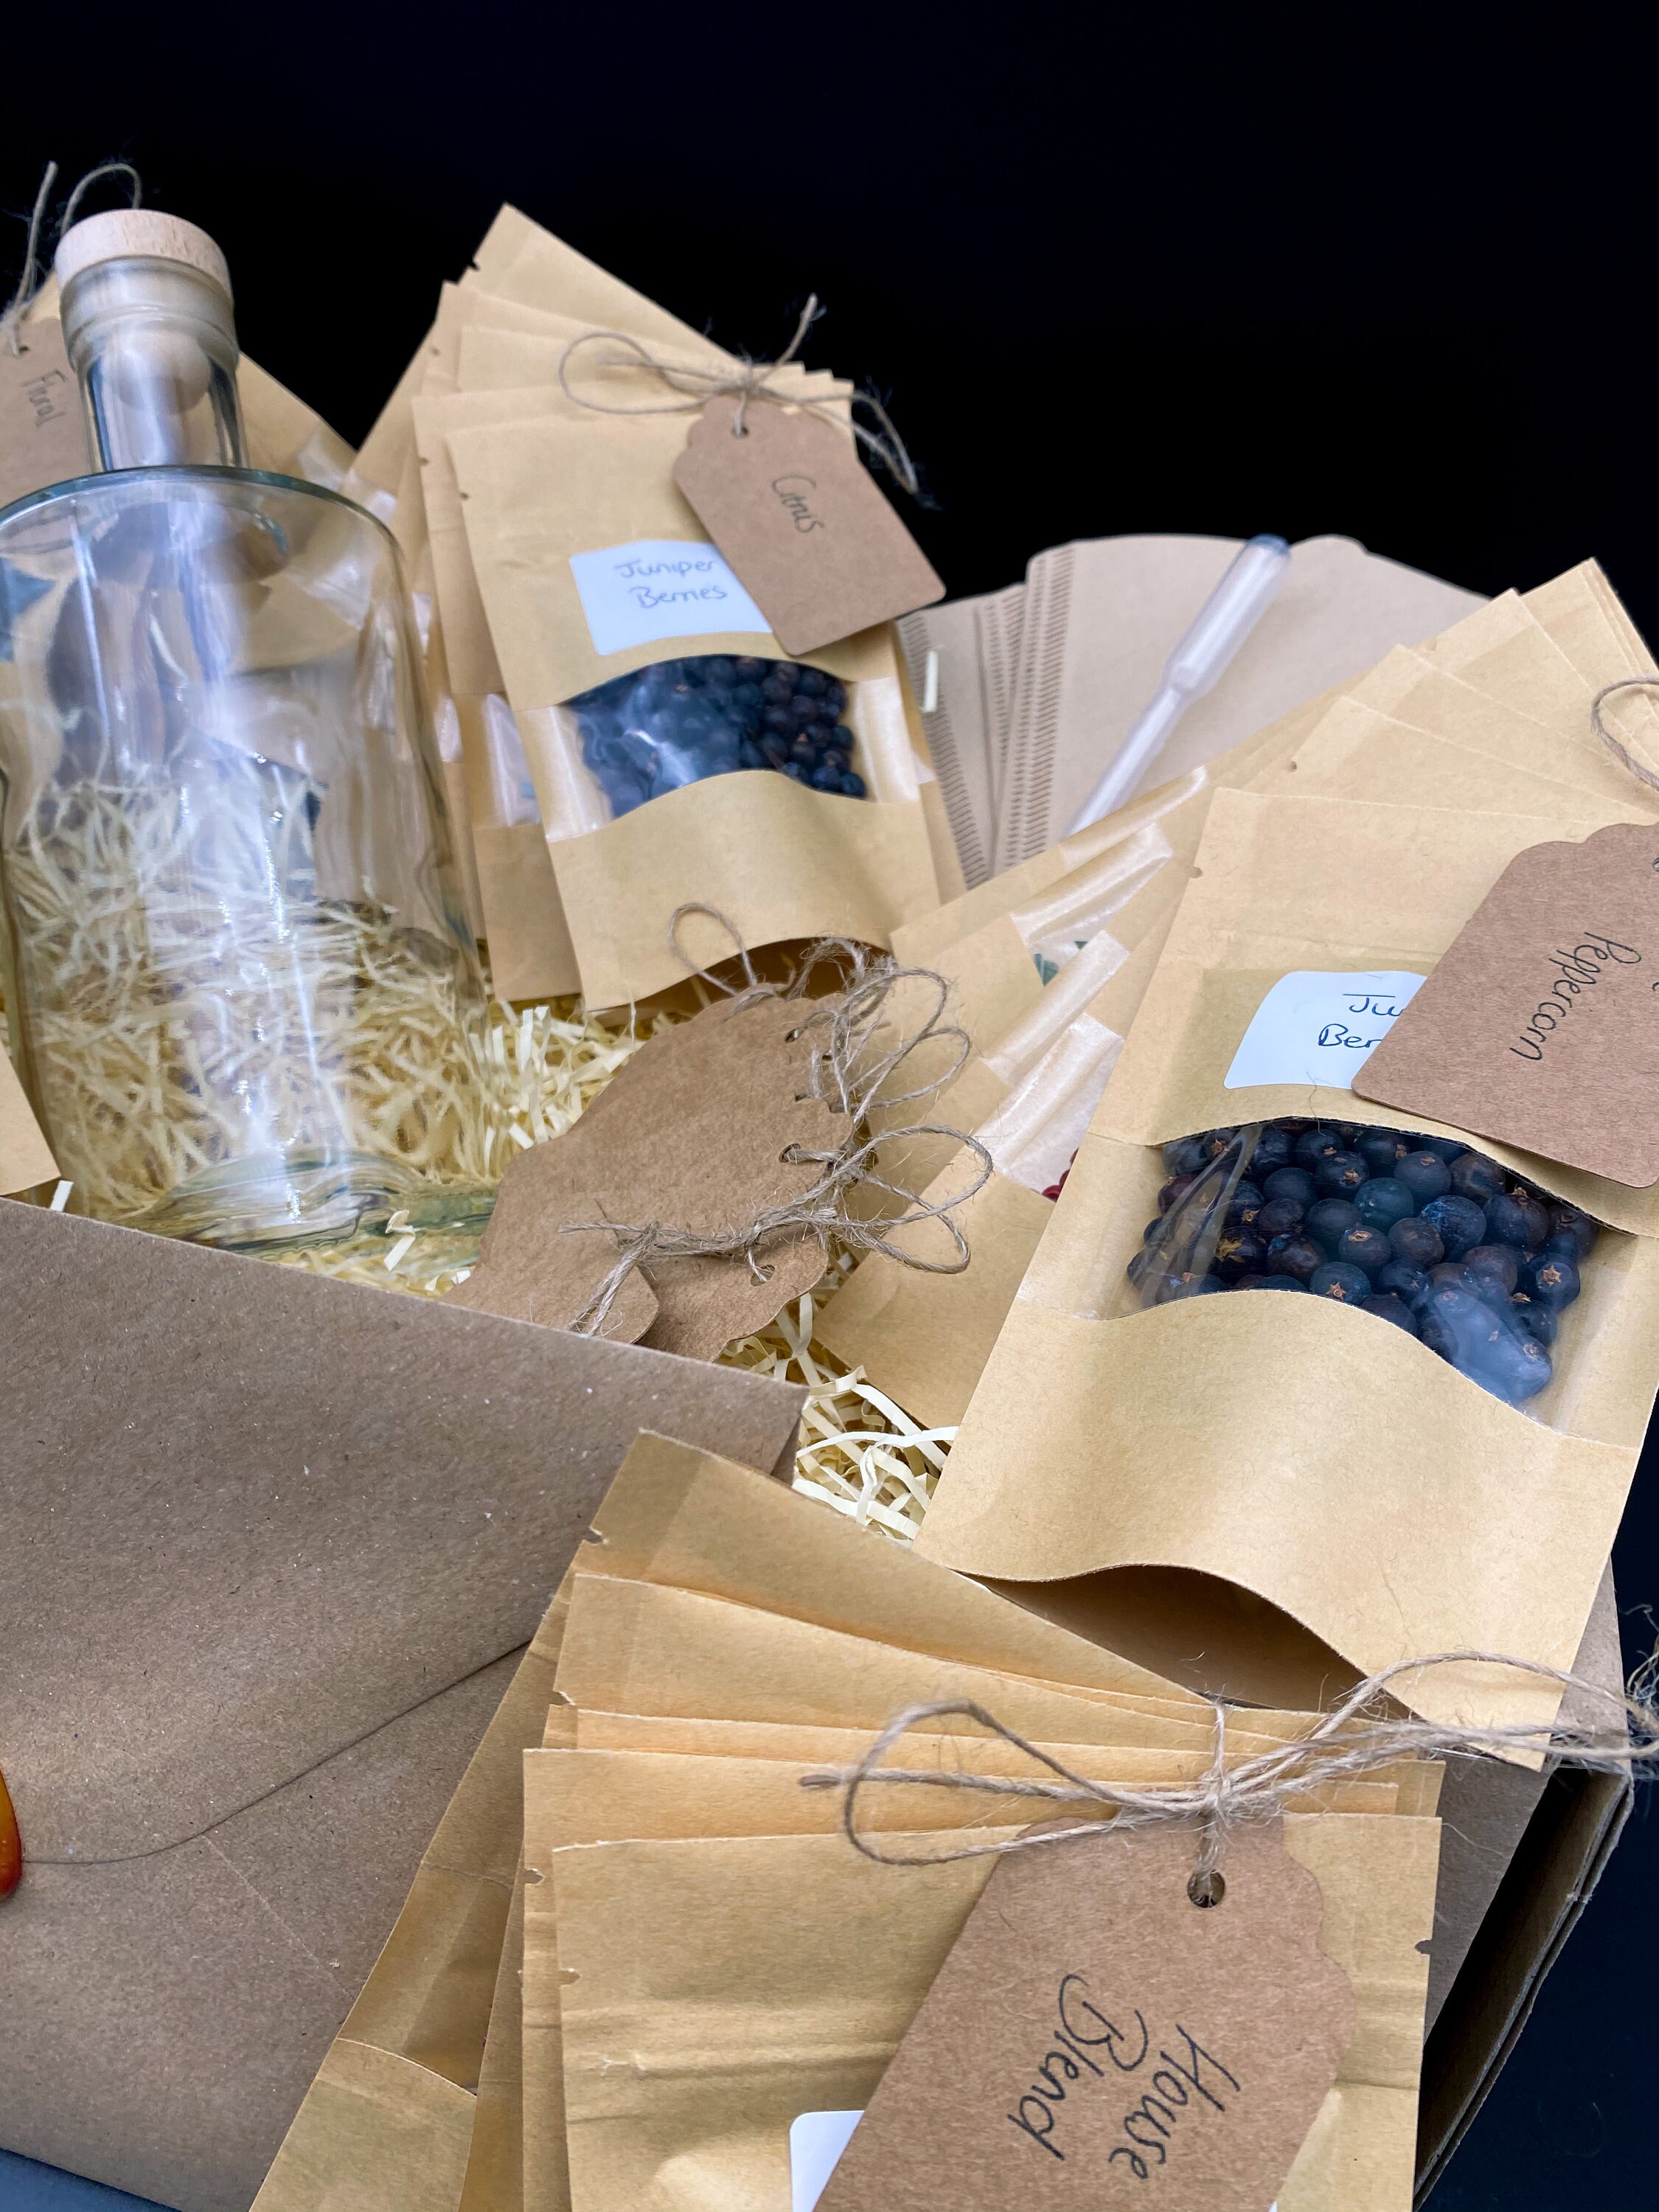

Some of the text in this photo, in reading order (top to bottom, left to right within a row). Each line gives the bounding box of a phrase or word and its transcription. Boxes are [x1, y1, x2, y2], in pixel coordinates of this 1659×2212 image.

[771, 473, 824, 533] Citrus
[613, 559, 715, 578] Juniper
[629, 585, 727, 609] Berries
[1509, 931, 1641, 1060] Peppercorn
[1318, 1023, 1382, 1048] Ber
[1007, 1974, 1149, 2160] Blend
[1108, 2024, 1241, 2180] House
